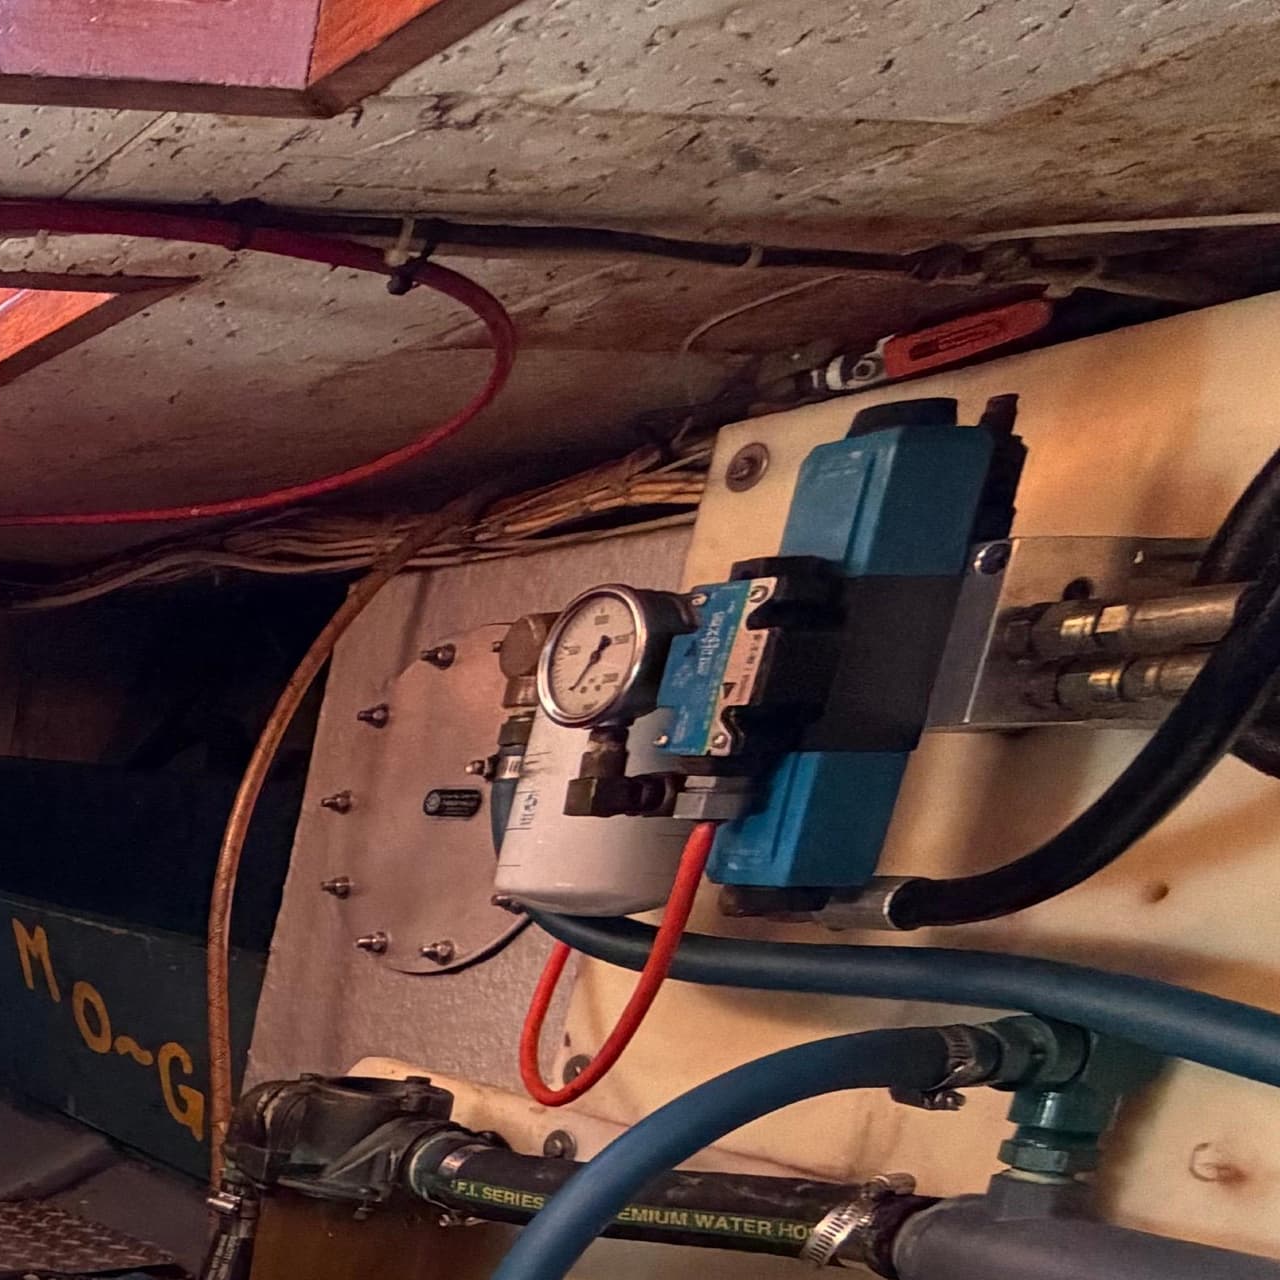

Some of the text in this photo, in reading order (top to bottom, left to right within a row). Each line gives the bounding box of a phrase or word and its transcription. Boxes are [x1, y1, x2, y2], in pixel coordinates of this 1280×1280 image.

[481, 1186, 545, 1210] SERIES
[617, 1207, 689, 1226] EMIUM
[694, 1213, 772, 1236] WATER
[778, 1223, 815, 1241] HO
